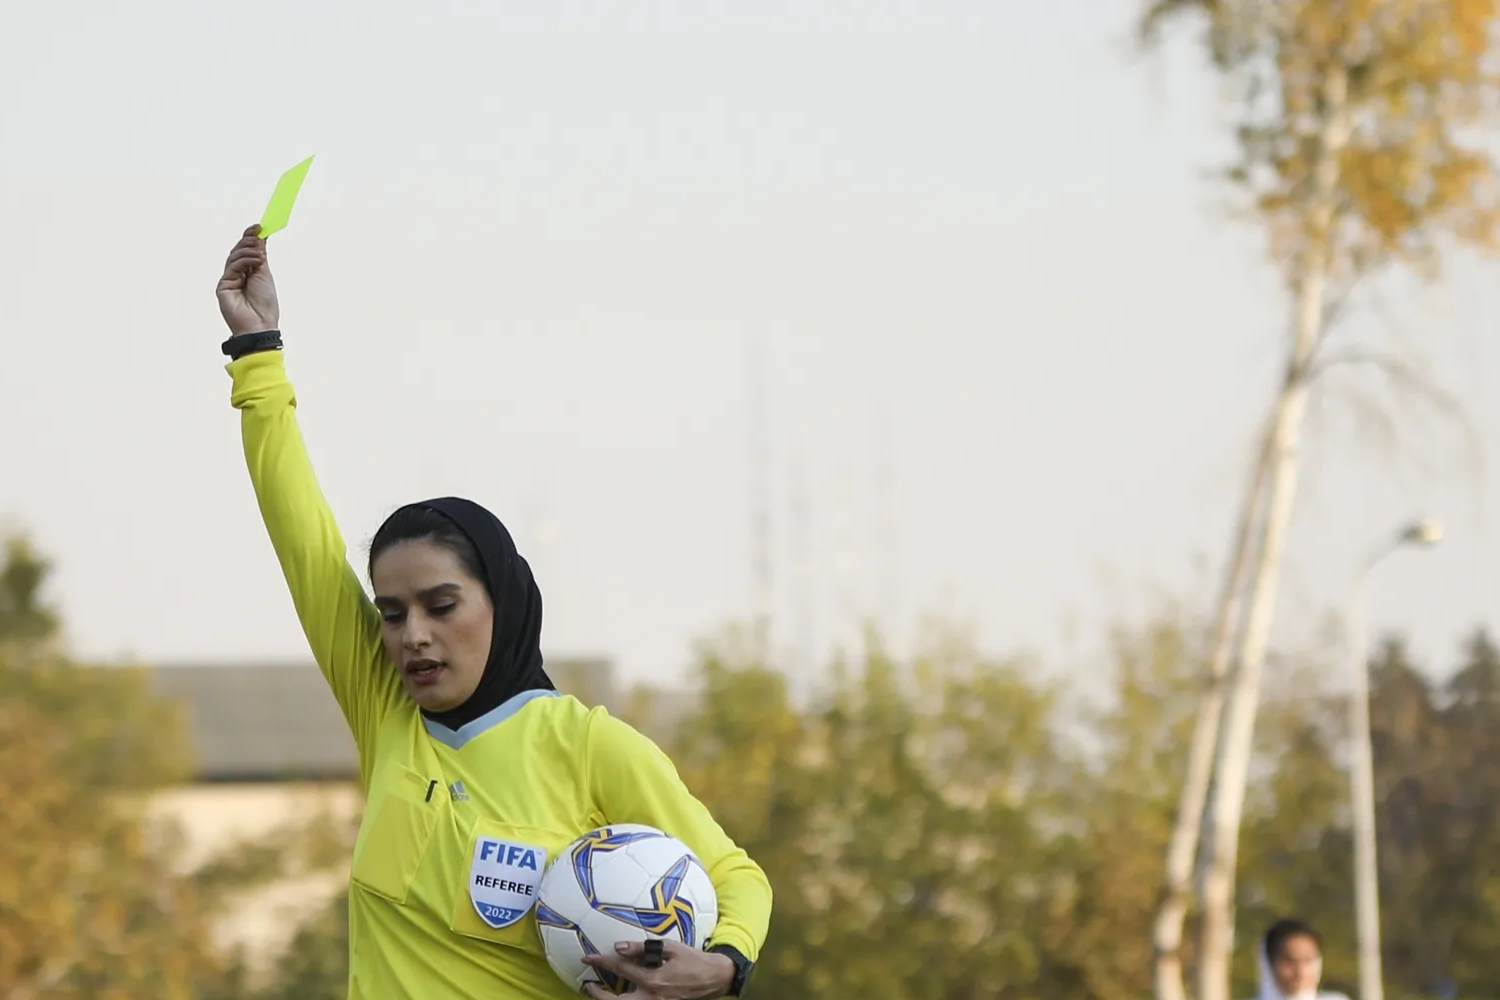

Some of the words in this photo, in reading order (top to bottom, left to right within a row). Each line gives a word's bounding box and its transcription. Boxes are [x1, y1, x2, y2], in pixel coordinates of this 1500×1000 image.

[480, 841, 537, 871] FIFA
[475, 875, 533, 896] REFEREE
[485, 906, 512, 920] 2022
